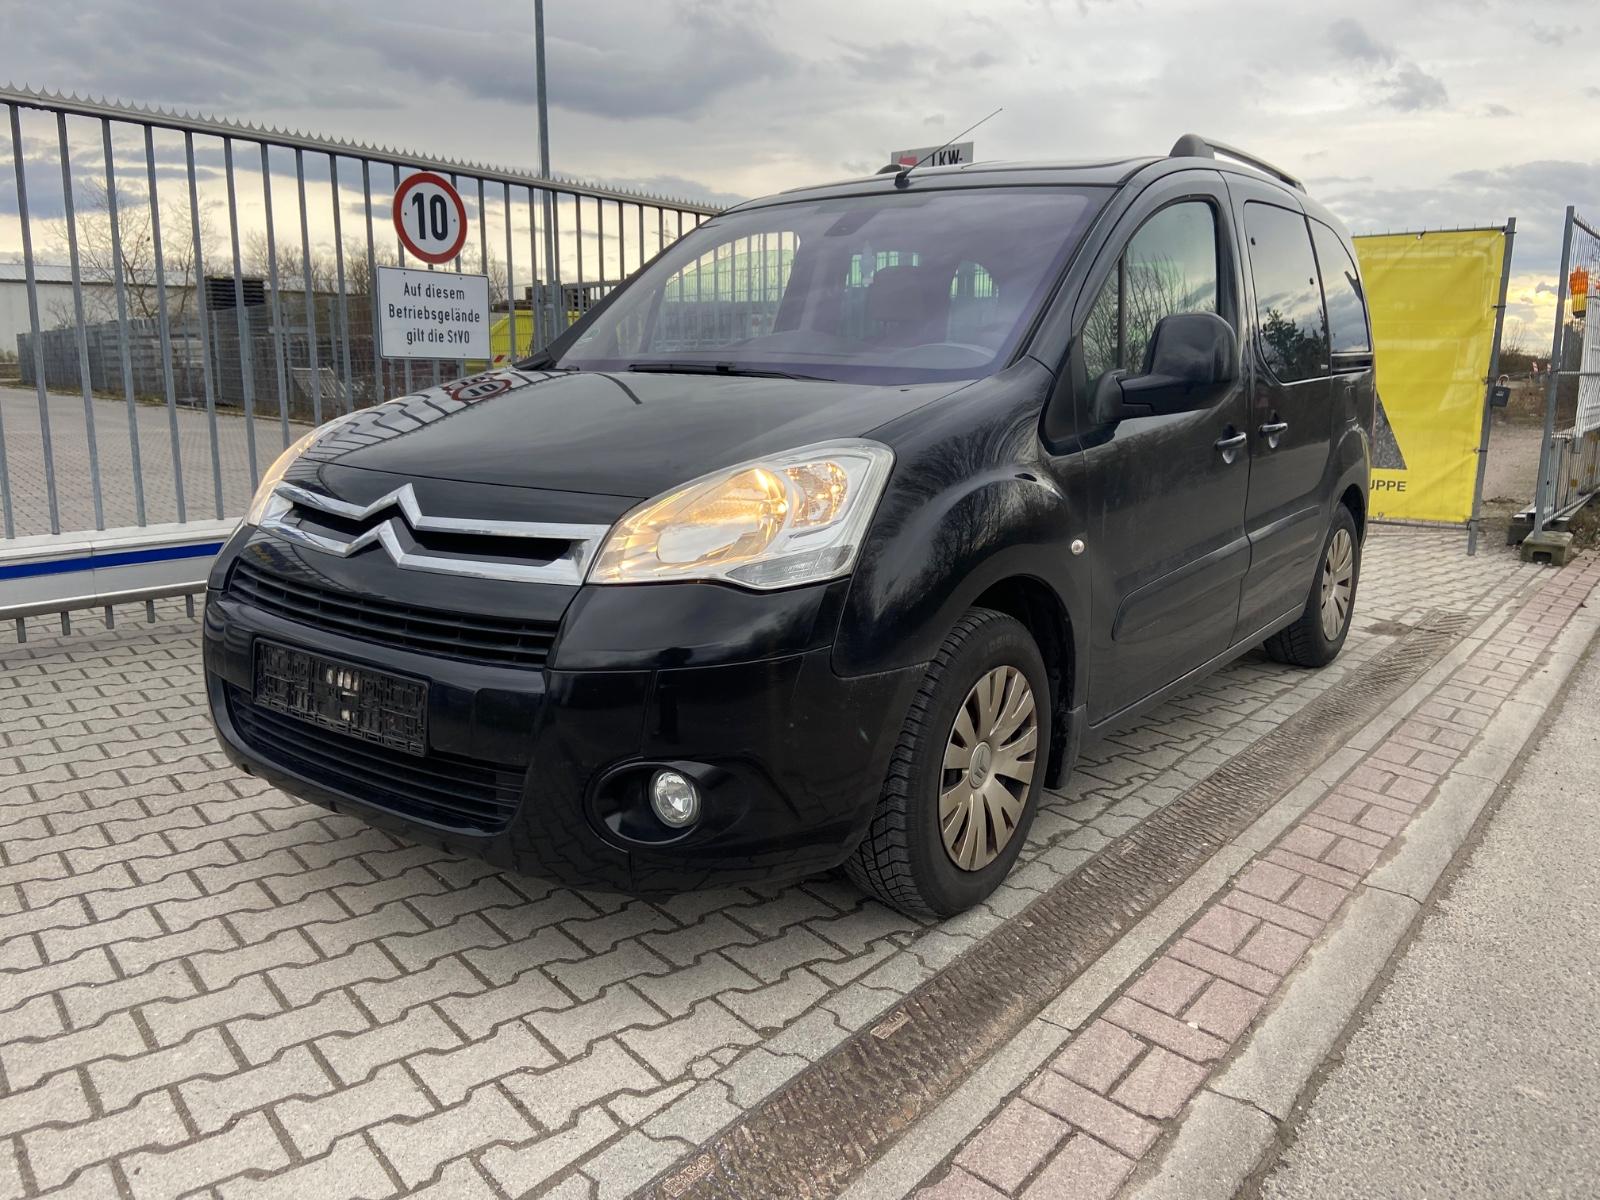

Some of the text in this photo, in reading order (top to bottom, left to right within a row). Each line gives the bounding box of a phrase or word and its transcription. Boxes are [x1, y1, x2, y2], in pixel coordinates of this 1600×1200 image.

[412, 192, 448, 241] 10
[404, 282, 465, 300] Auf diesem
[389, 304, 480, 324] Betriebsgelände
[407, 329, 470, 345] gilt die StVO
